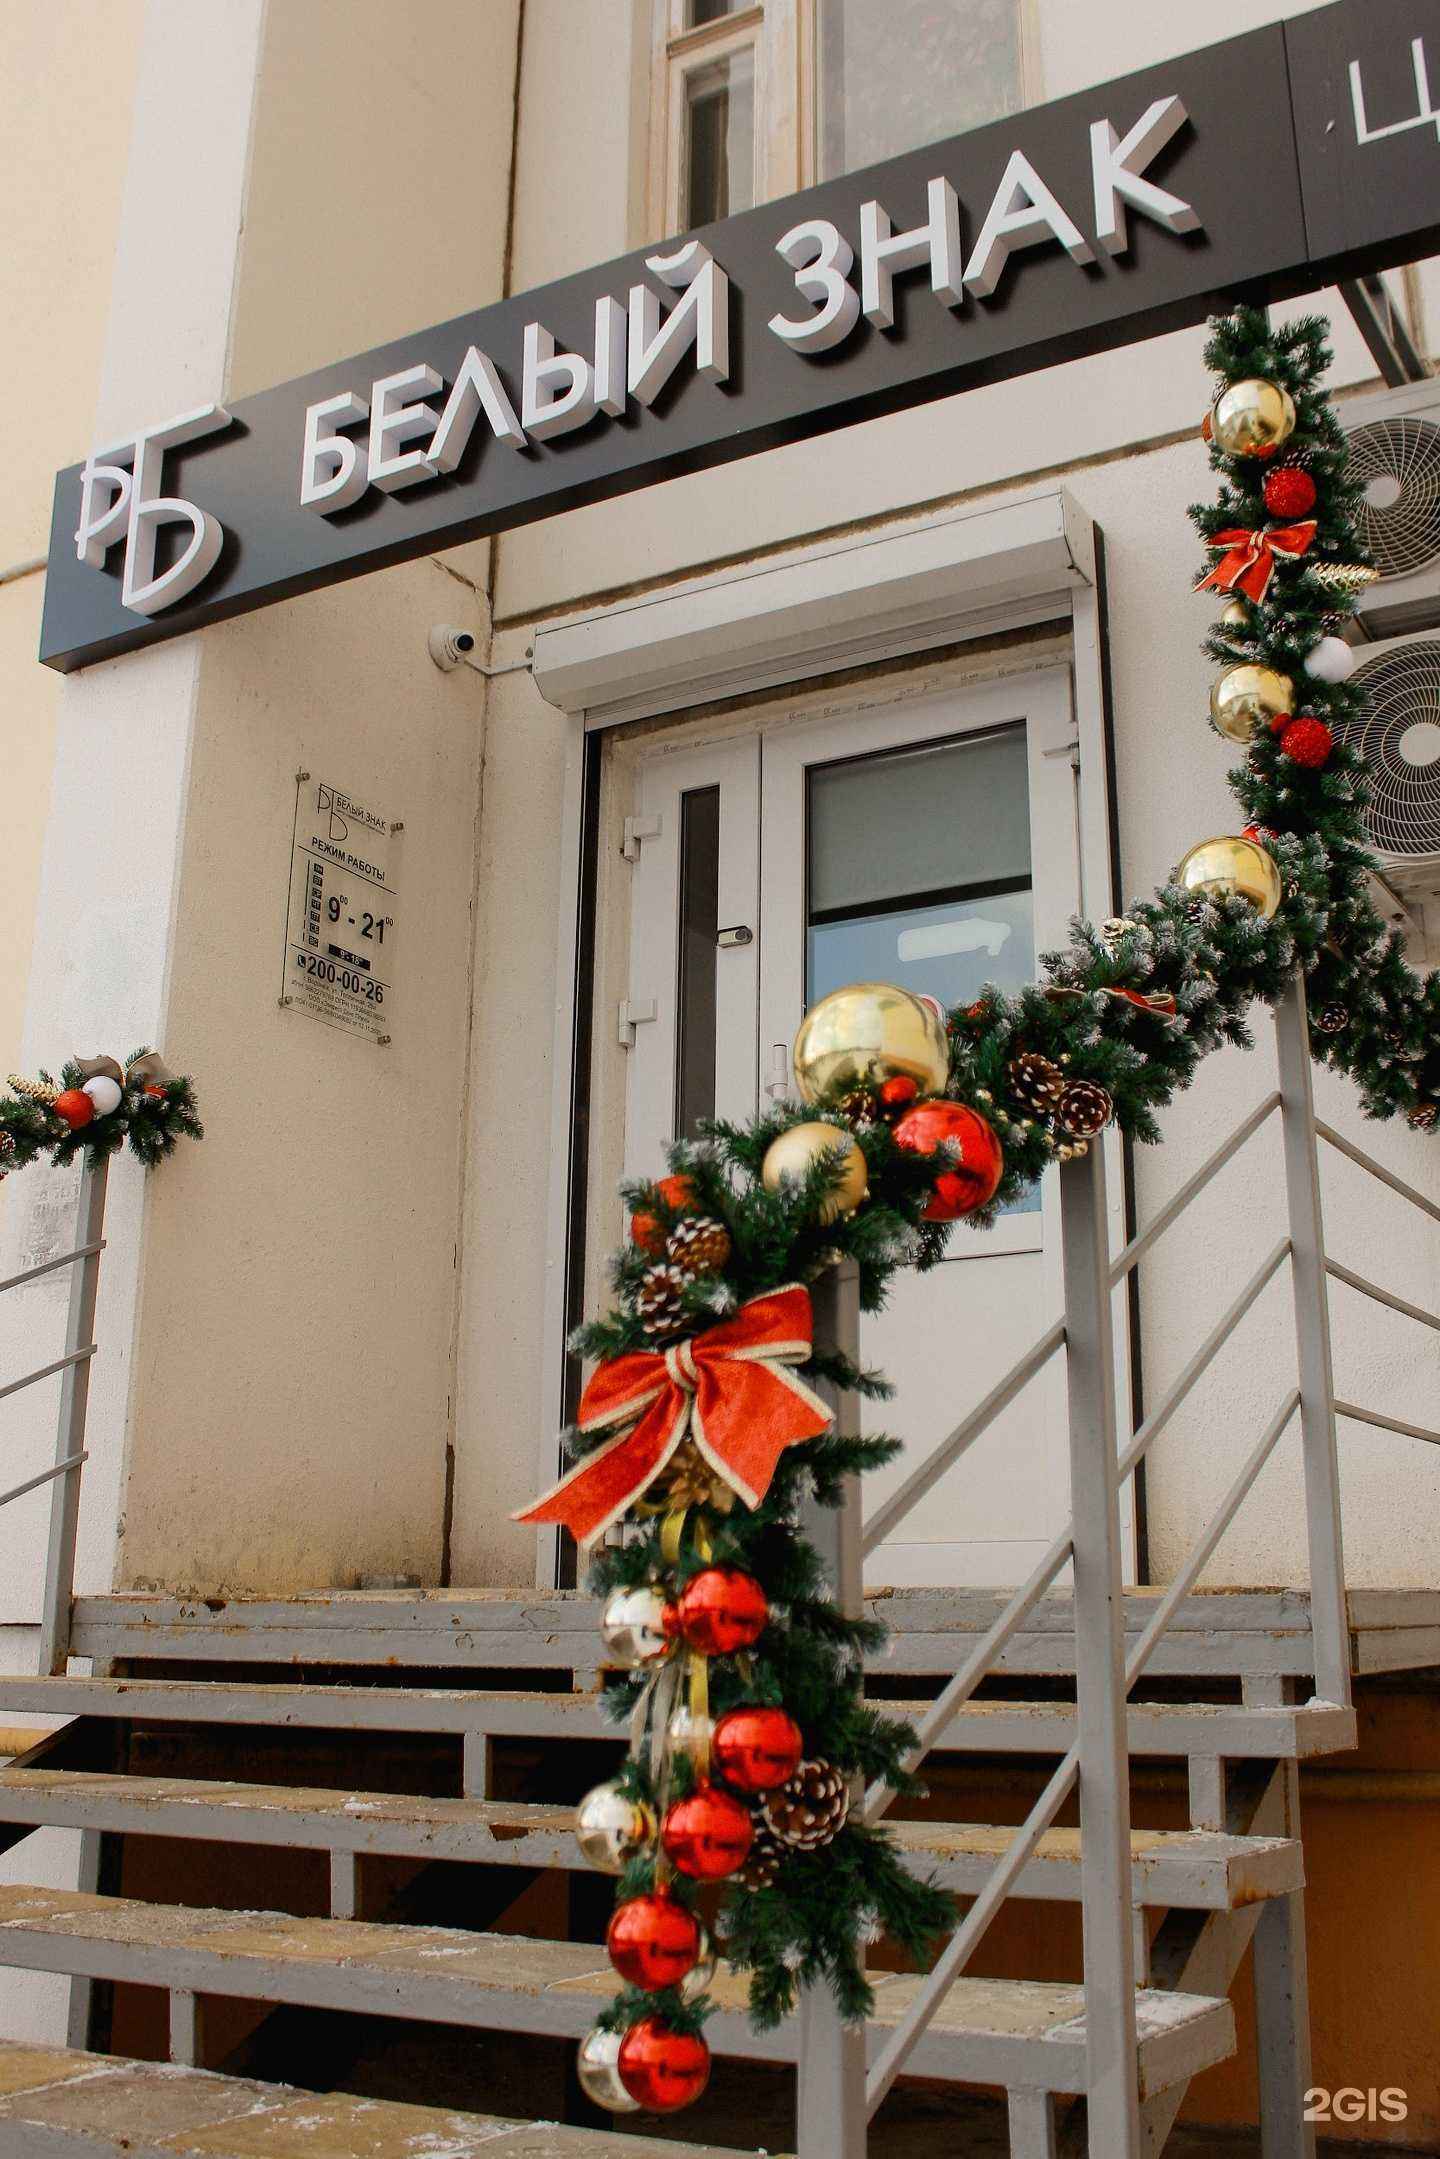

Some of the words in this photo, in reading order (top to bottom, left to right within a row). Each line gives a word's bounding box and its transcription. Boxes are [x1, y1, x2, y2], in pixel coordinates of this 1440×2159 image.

[300, 240, 729, 516] БЕЛЫЙ
[767, 95, 1203, 354] ЗНАК
[336, 797, 364, 820] БЕЛЫЙ
[366, 812, 387, 831] ЗНАК
[311, 836, 346, 863] РЕЖИМ
[347, 854, 385, 881] РАБОТЫ
[307, 956, 384, 1004] 200-00-26
